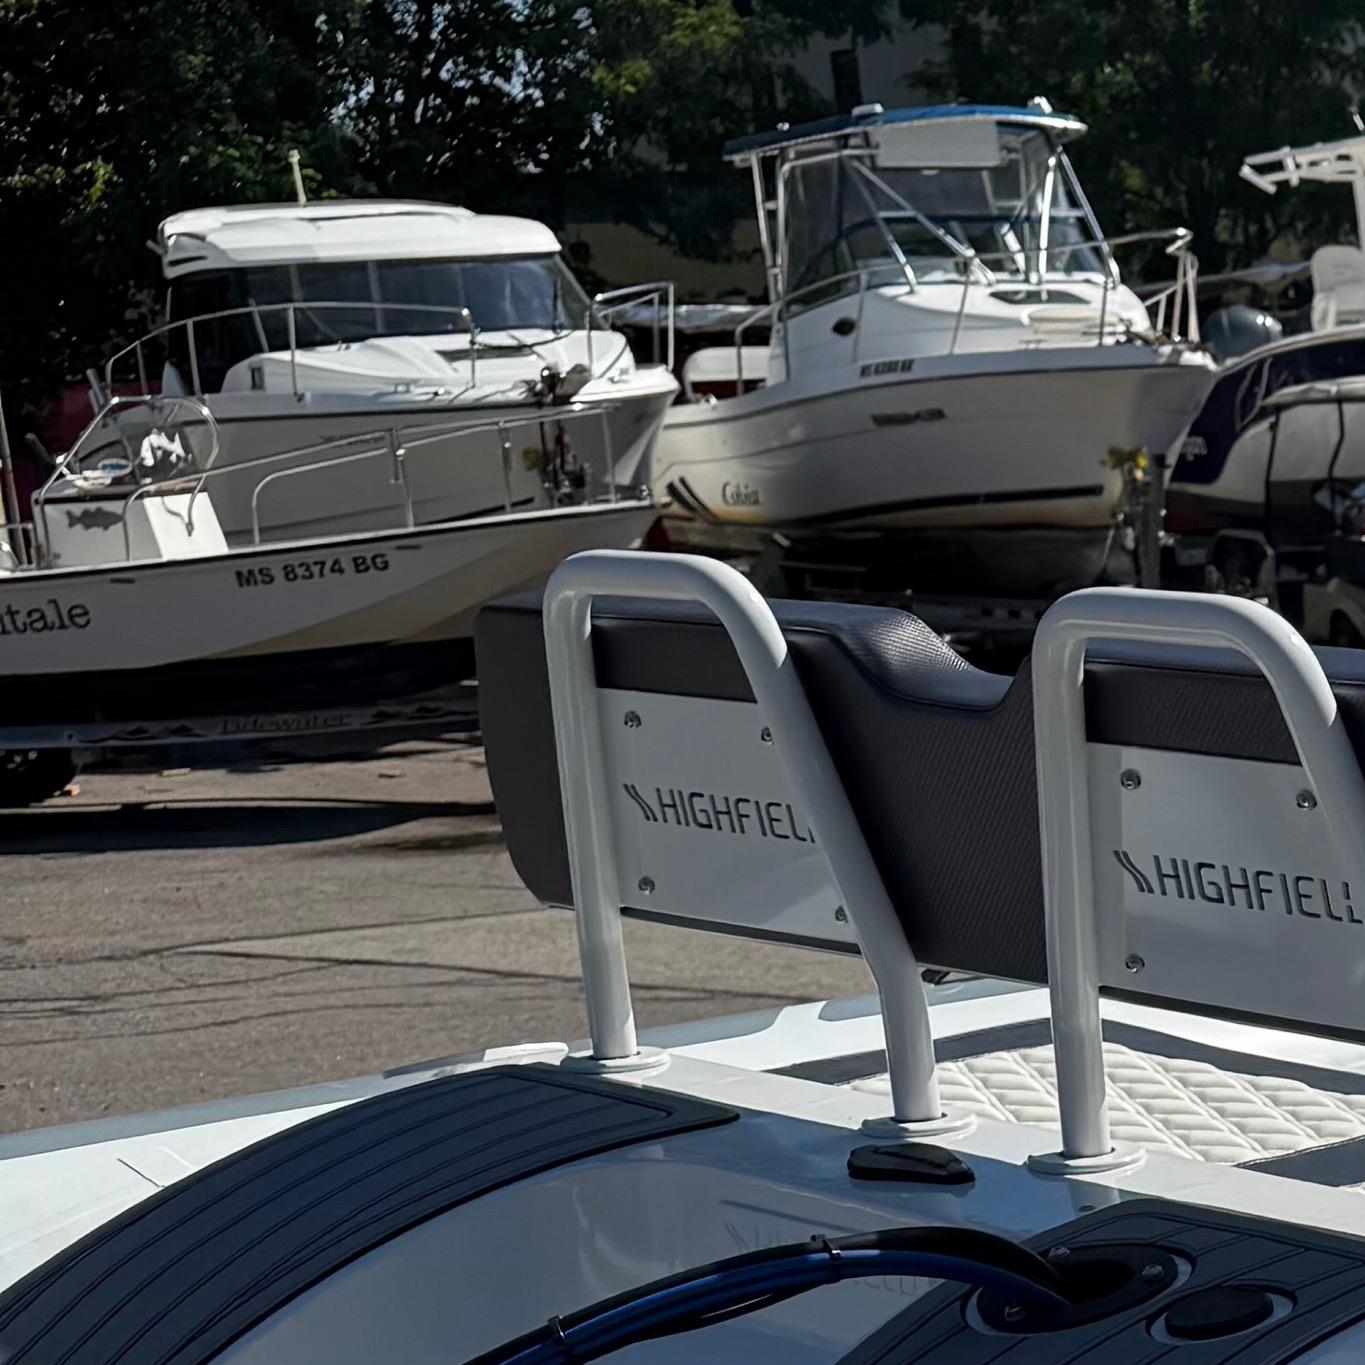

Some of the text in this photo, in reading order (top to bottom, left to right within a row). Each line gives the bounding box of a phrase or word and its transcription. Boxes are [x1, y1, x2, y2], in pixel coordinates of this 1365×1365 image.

[236, 553, 390, 587] MS 8374 BG
[656, 787, 816, 844] HIGHFIEL
